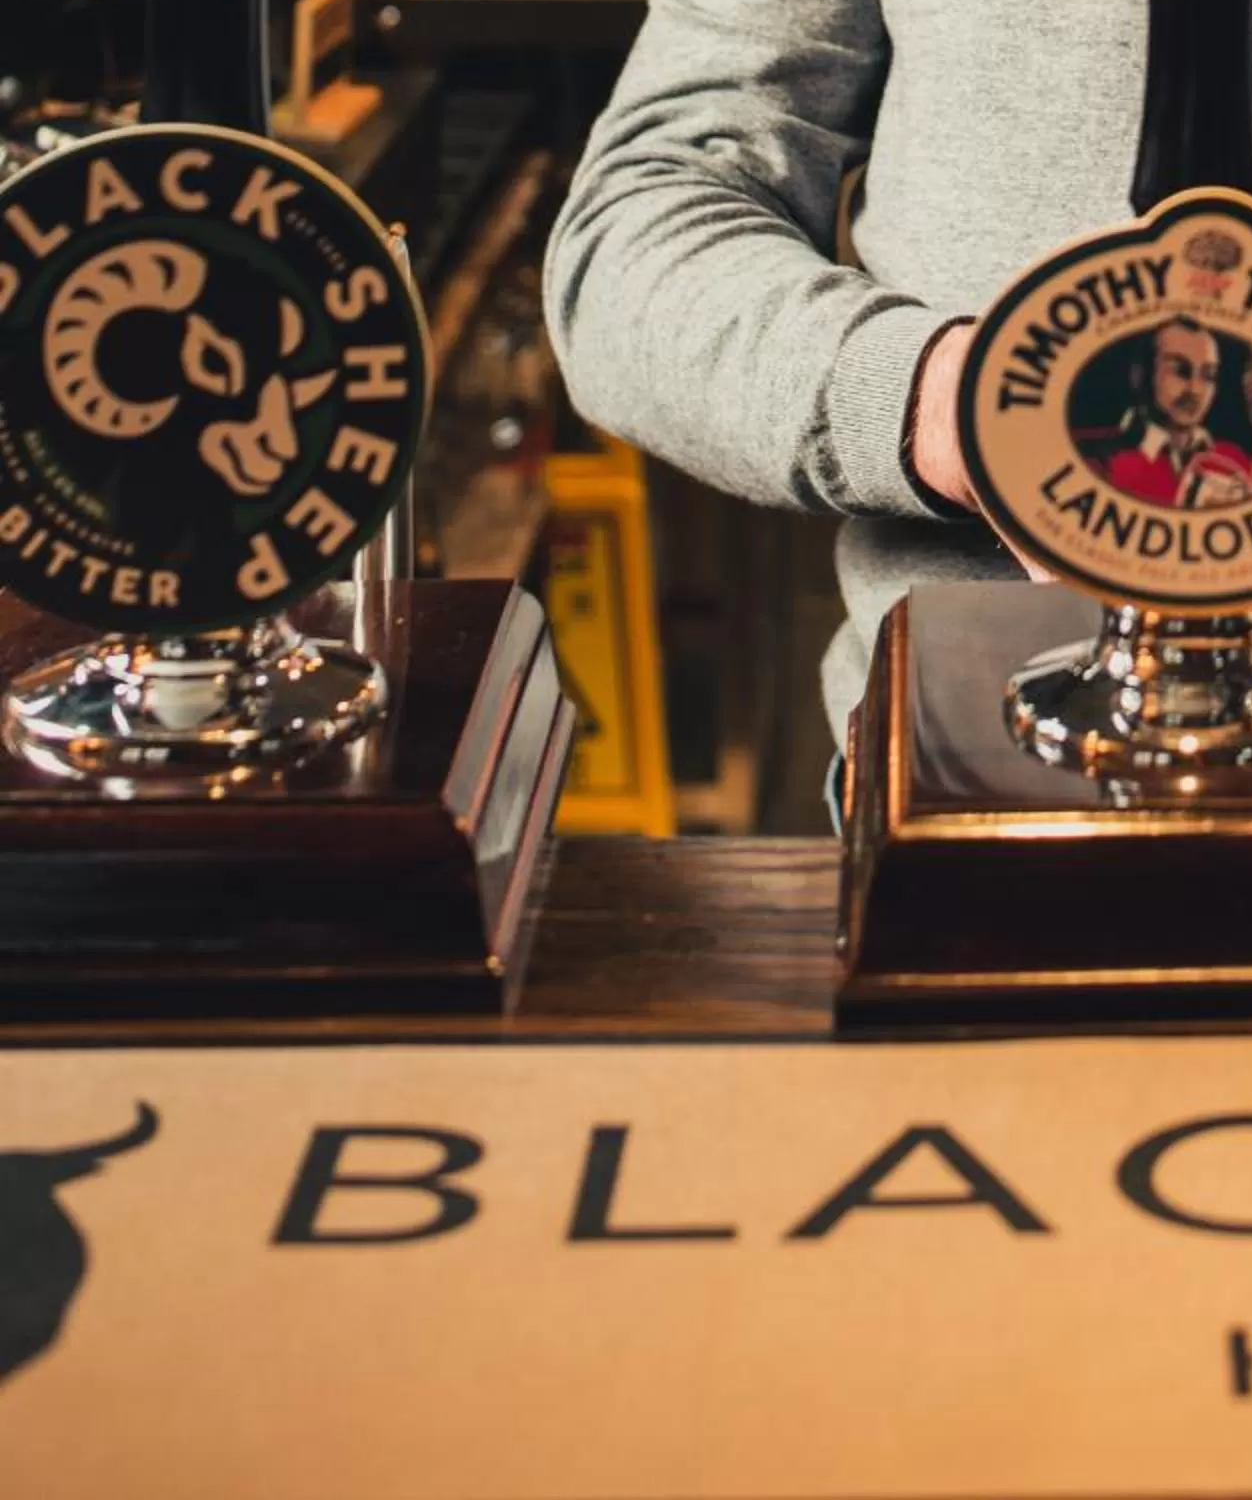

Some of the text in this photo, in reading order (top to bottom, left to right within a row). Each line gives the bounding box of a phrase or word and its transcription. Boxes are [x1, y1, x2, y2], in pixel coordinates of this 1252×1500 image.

[997, 255, 1174, 414] TIMOTHY
[236, 265, 408, 600] SHEEP
[0, 504, 181, 608] BITTER
